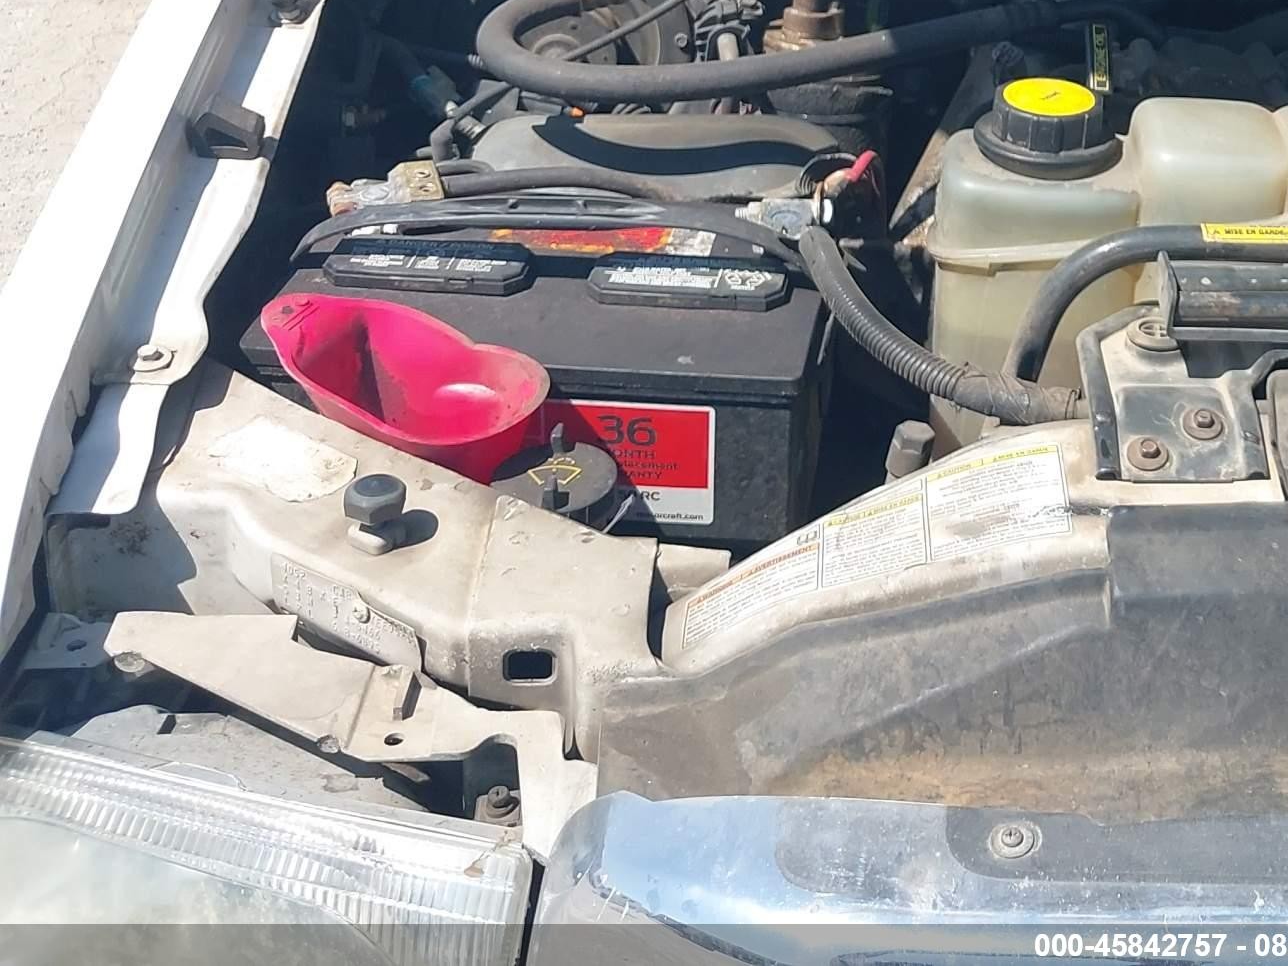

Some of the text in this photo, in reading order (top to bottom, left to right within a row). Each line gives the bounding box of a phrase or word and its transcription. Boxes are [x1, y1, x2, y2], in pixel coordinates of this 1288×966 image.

[597, 415, 657, 447] 36
[617, 459, 680, 471] lacement
[624, 471, 663, 480] ANTY
[641, 491, 662, 502] RC
[637, 511, 704, 522] orcraft.com
